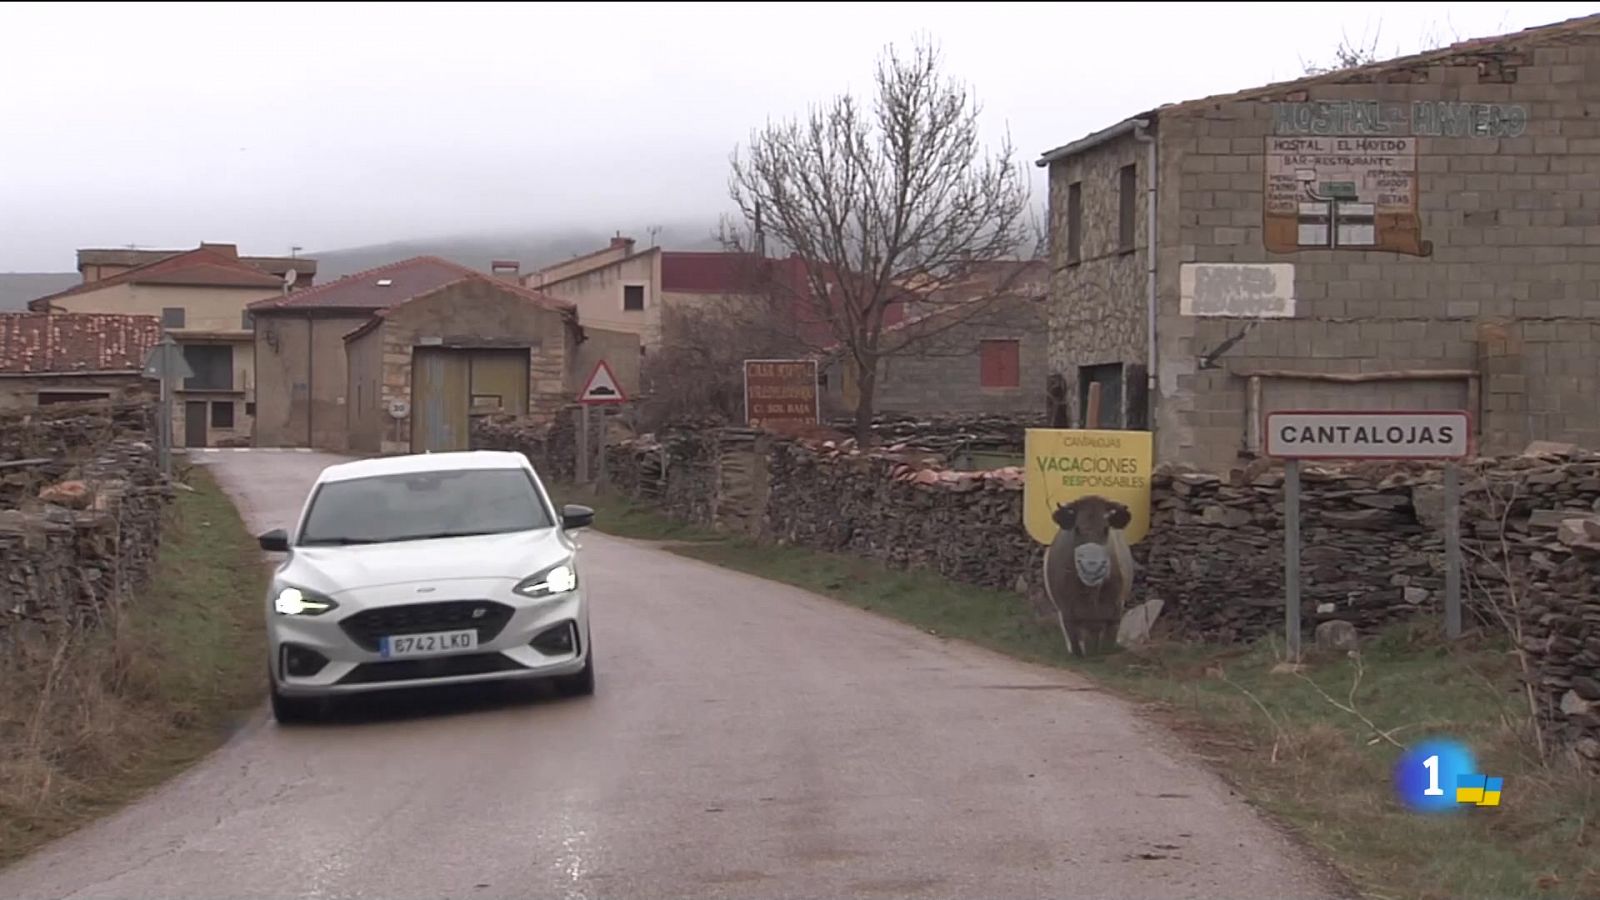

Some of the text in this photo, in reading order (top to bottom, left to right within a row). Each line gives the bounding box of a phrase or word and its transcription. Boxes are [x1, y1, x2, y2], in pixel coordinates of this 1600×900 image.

[1275, 100, 1388, 134] HOSTAL
[1273, 138, 1408, 151] HOSTAL EL HAYEDO
[1063, 436, 1122, 448] CANTALOJAS
[1280, 426, 1454, 444] CANTALOJAS
[1036, 456, 1138, 473] VACACIONES
[1062, 475, 1146, 488] RESPONSABLES
